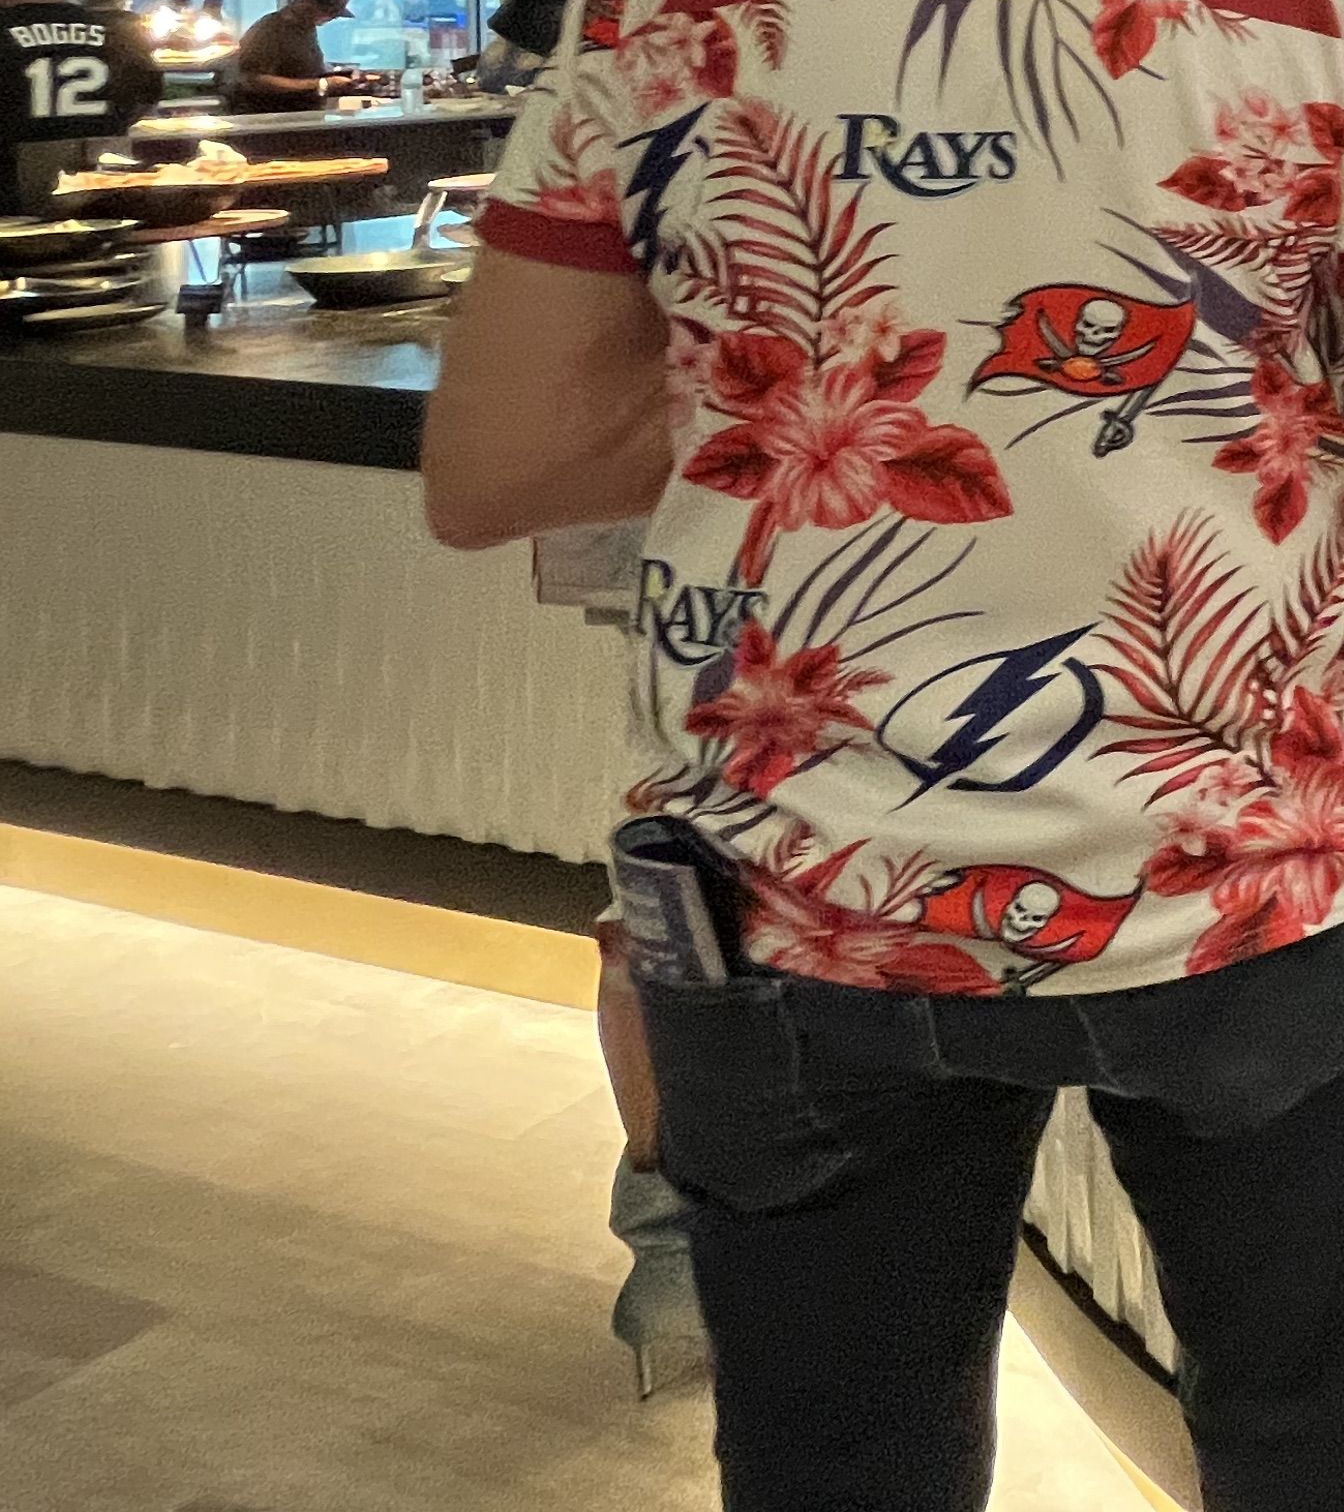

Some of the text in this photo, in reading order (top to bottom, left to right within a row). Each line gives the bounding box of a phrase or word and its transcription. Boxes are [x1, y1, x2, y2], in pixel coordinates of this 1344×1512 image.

[9, 22, 107, 48] BOGGS
[25, 55, 110, 119] 12
[831, 113, 1018, 198] RAYS
